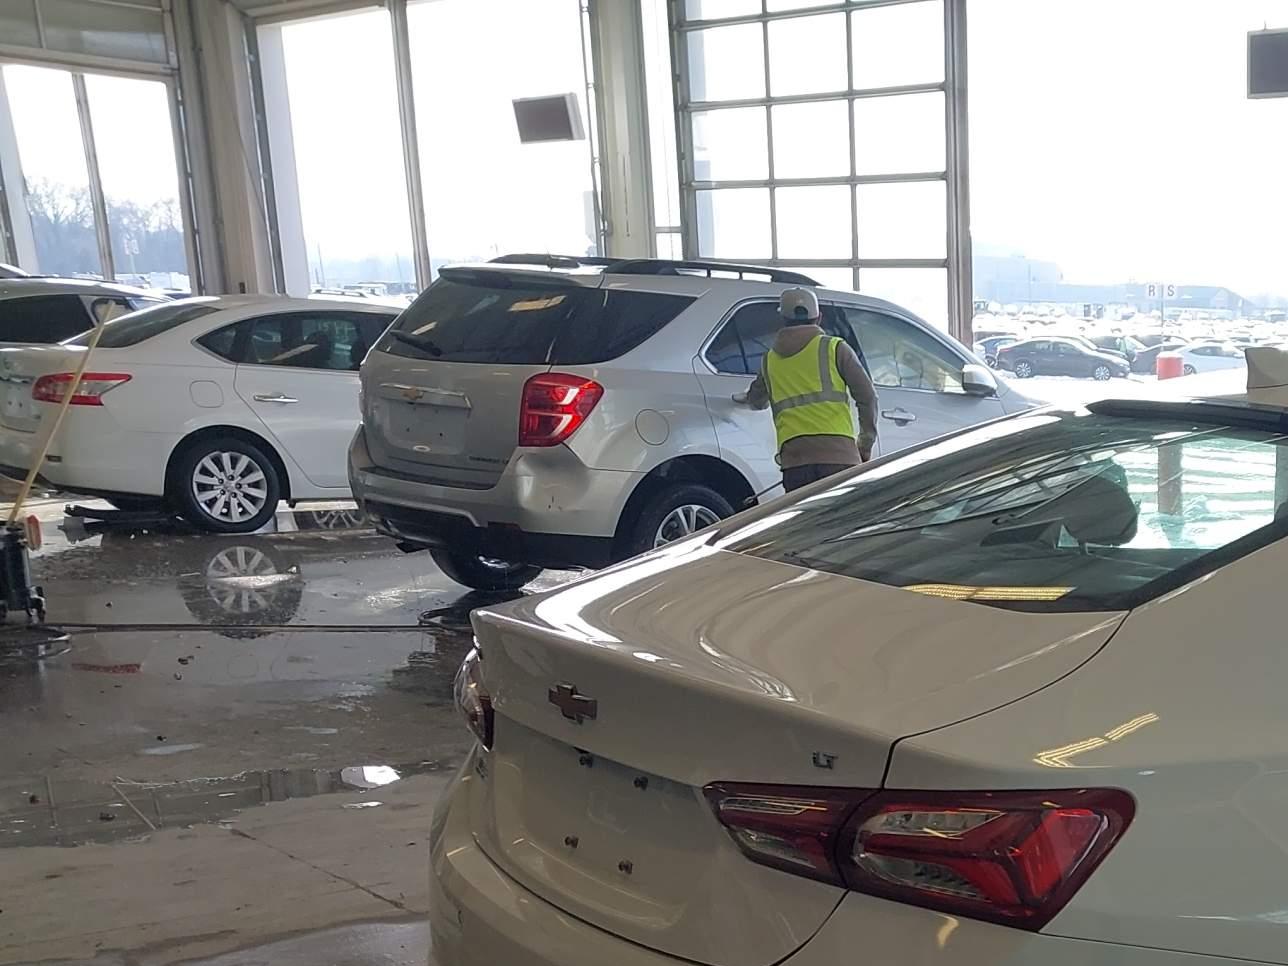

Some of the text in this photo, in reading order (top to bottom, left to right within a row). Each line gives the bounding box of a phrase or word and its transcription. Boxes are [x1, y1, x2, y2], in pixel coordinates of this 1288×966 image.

[1148, 284, 1175, 297] R S
[812, 751, 839, 770] LT
